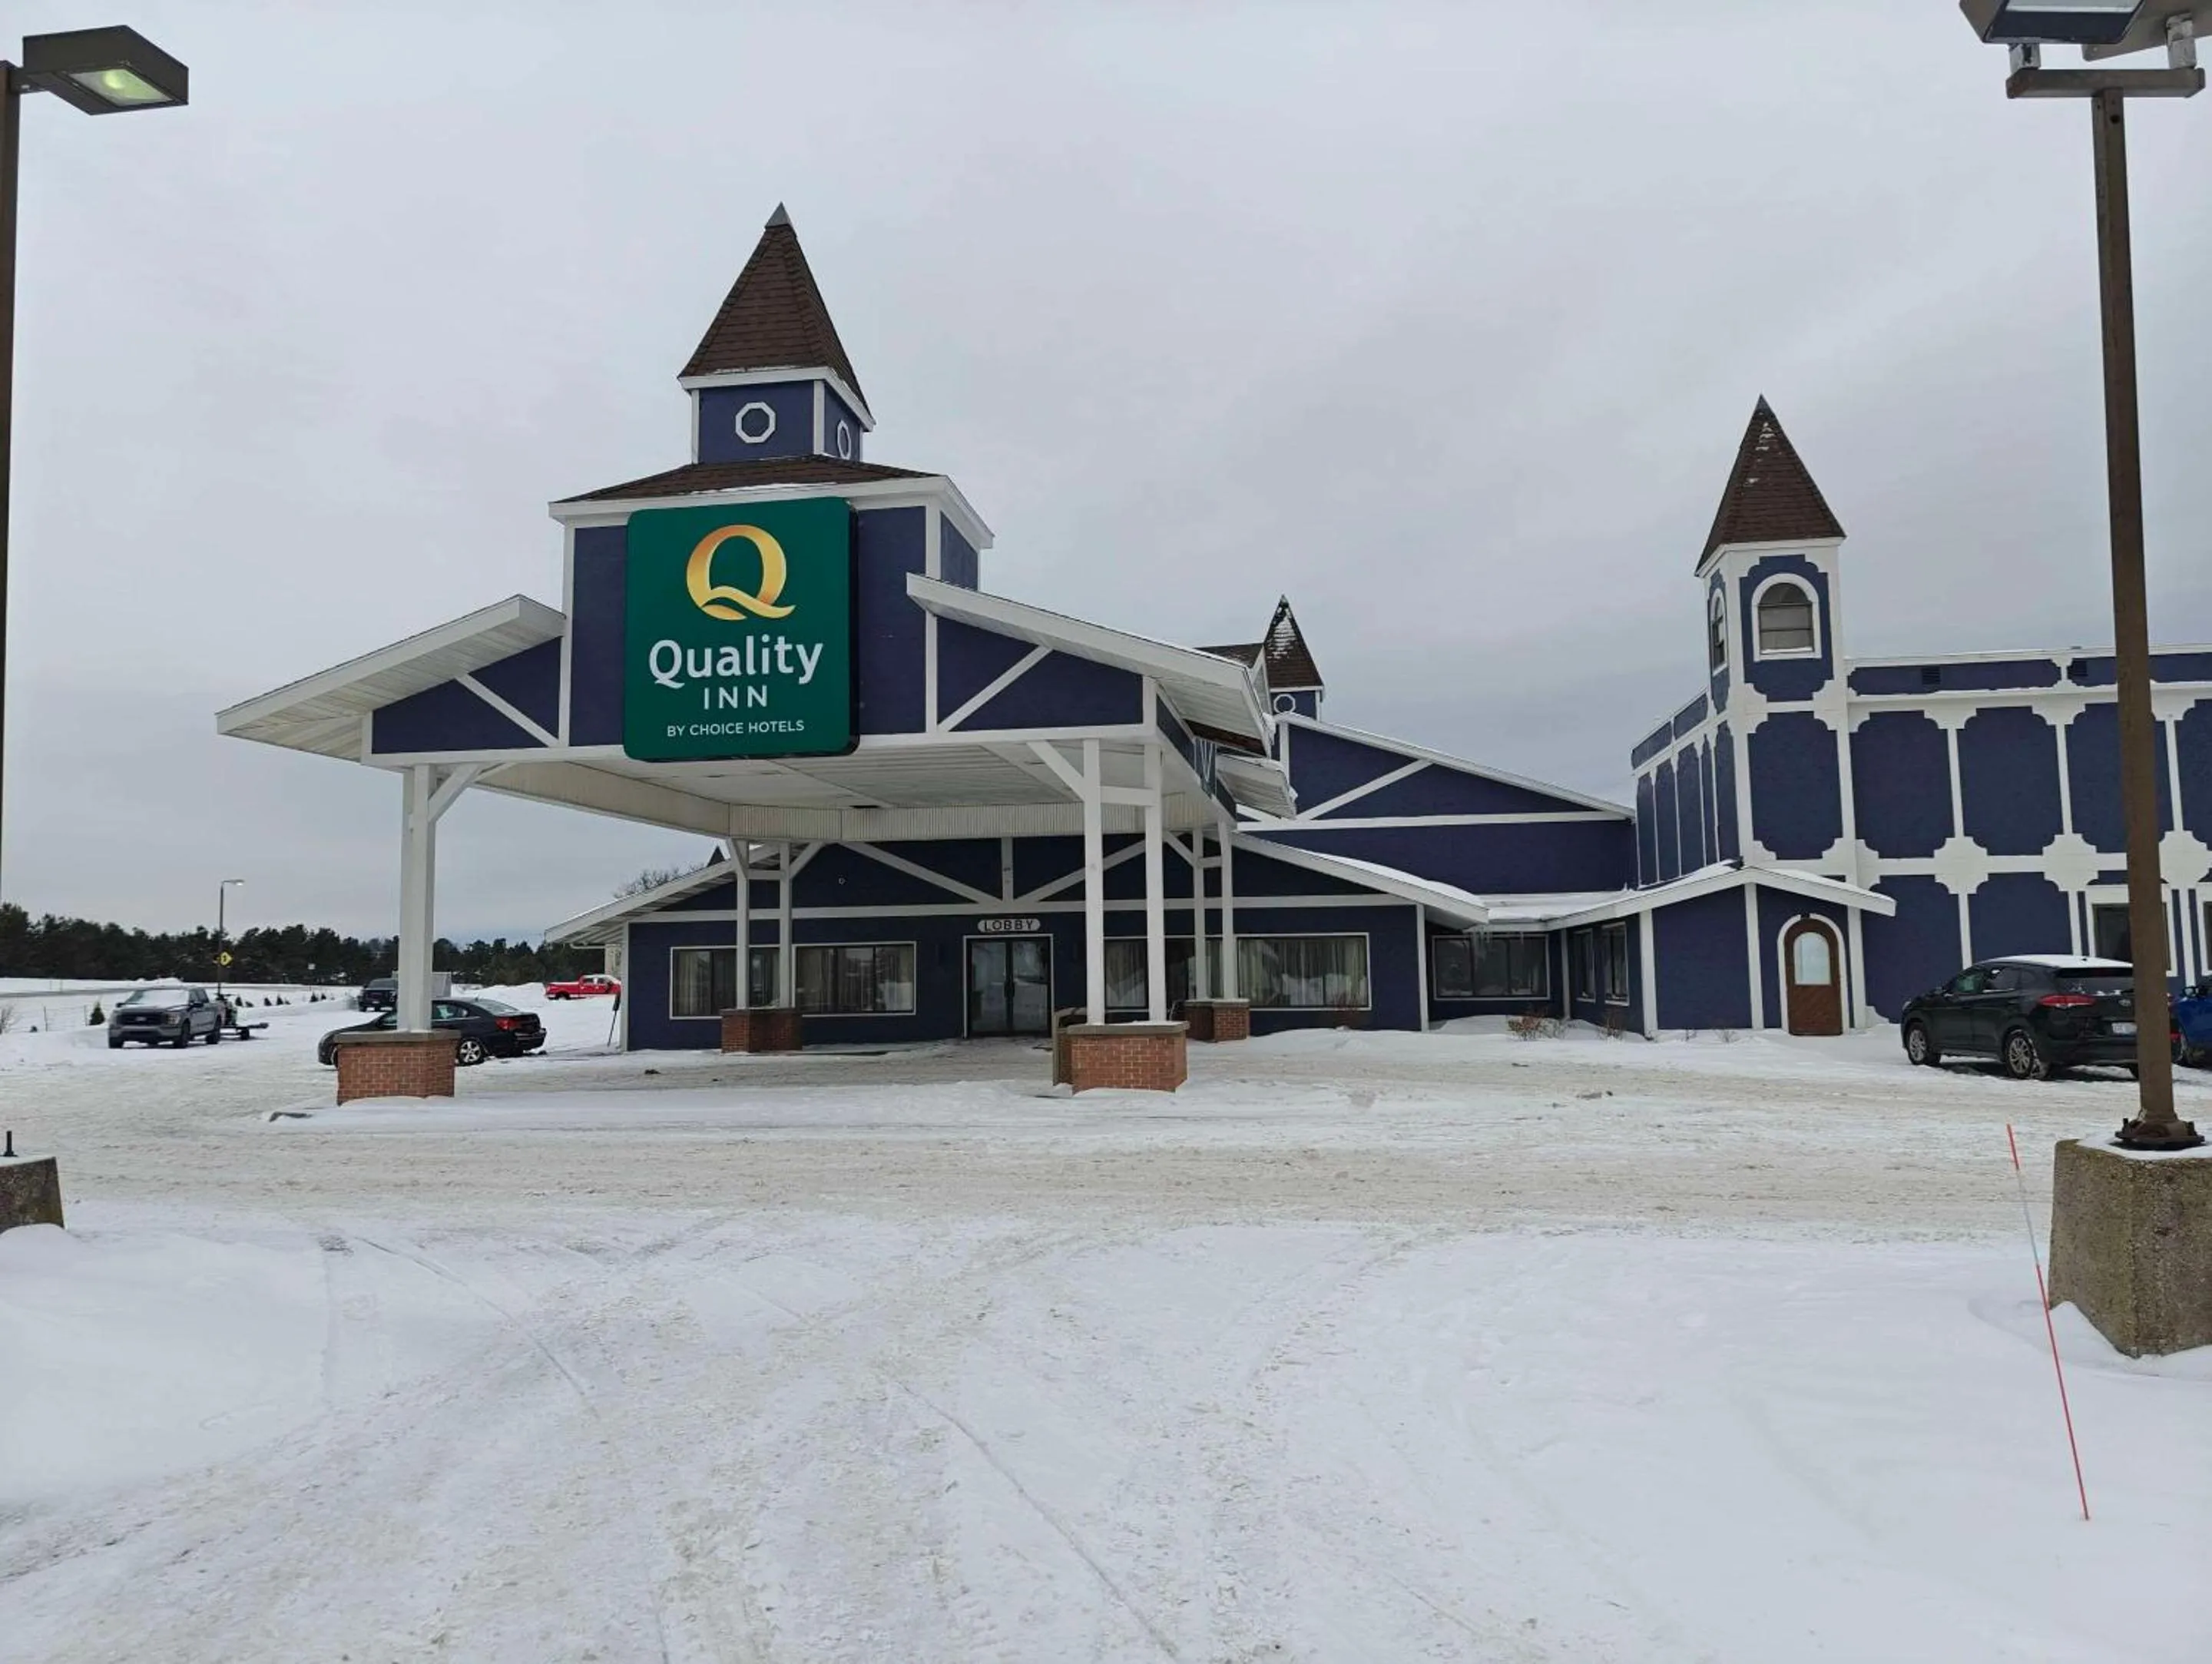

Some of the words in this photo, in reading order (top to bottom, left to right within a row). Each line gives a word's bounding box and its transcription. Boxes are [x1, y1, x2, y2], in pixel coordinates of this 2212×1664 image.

[686, 524, 796, 620] Q
[648, 635, 823, 689] Quality
[704, 684, 767, 710] INN
[667, 725, 686, 737] BY
[690, 722, 743, 735] CHOICE
[748, 720, 804, 733] HOTELS
[985, 919, 1033, 932] LOBBY
